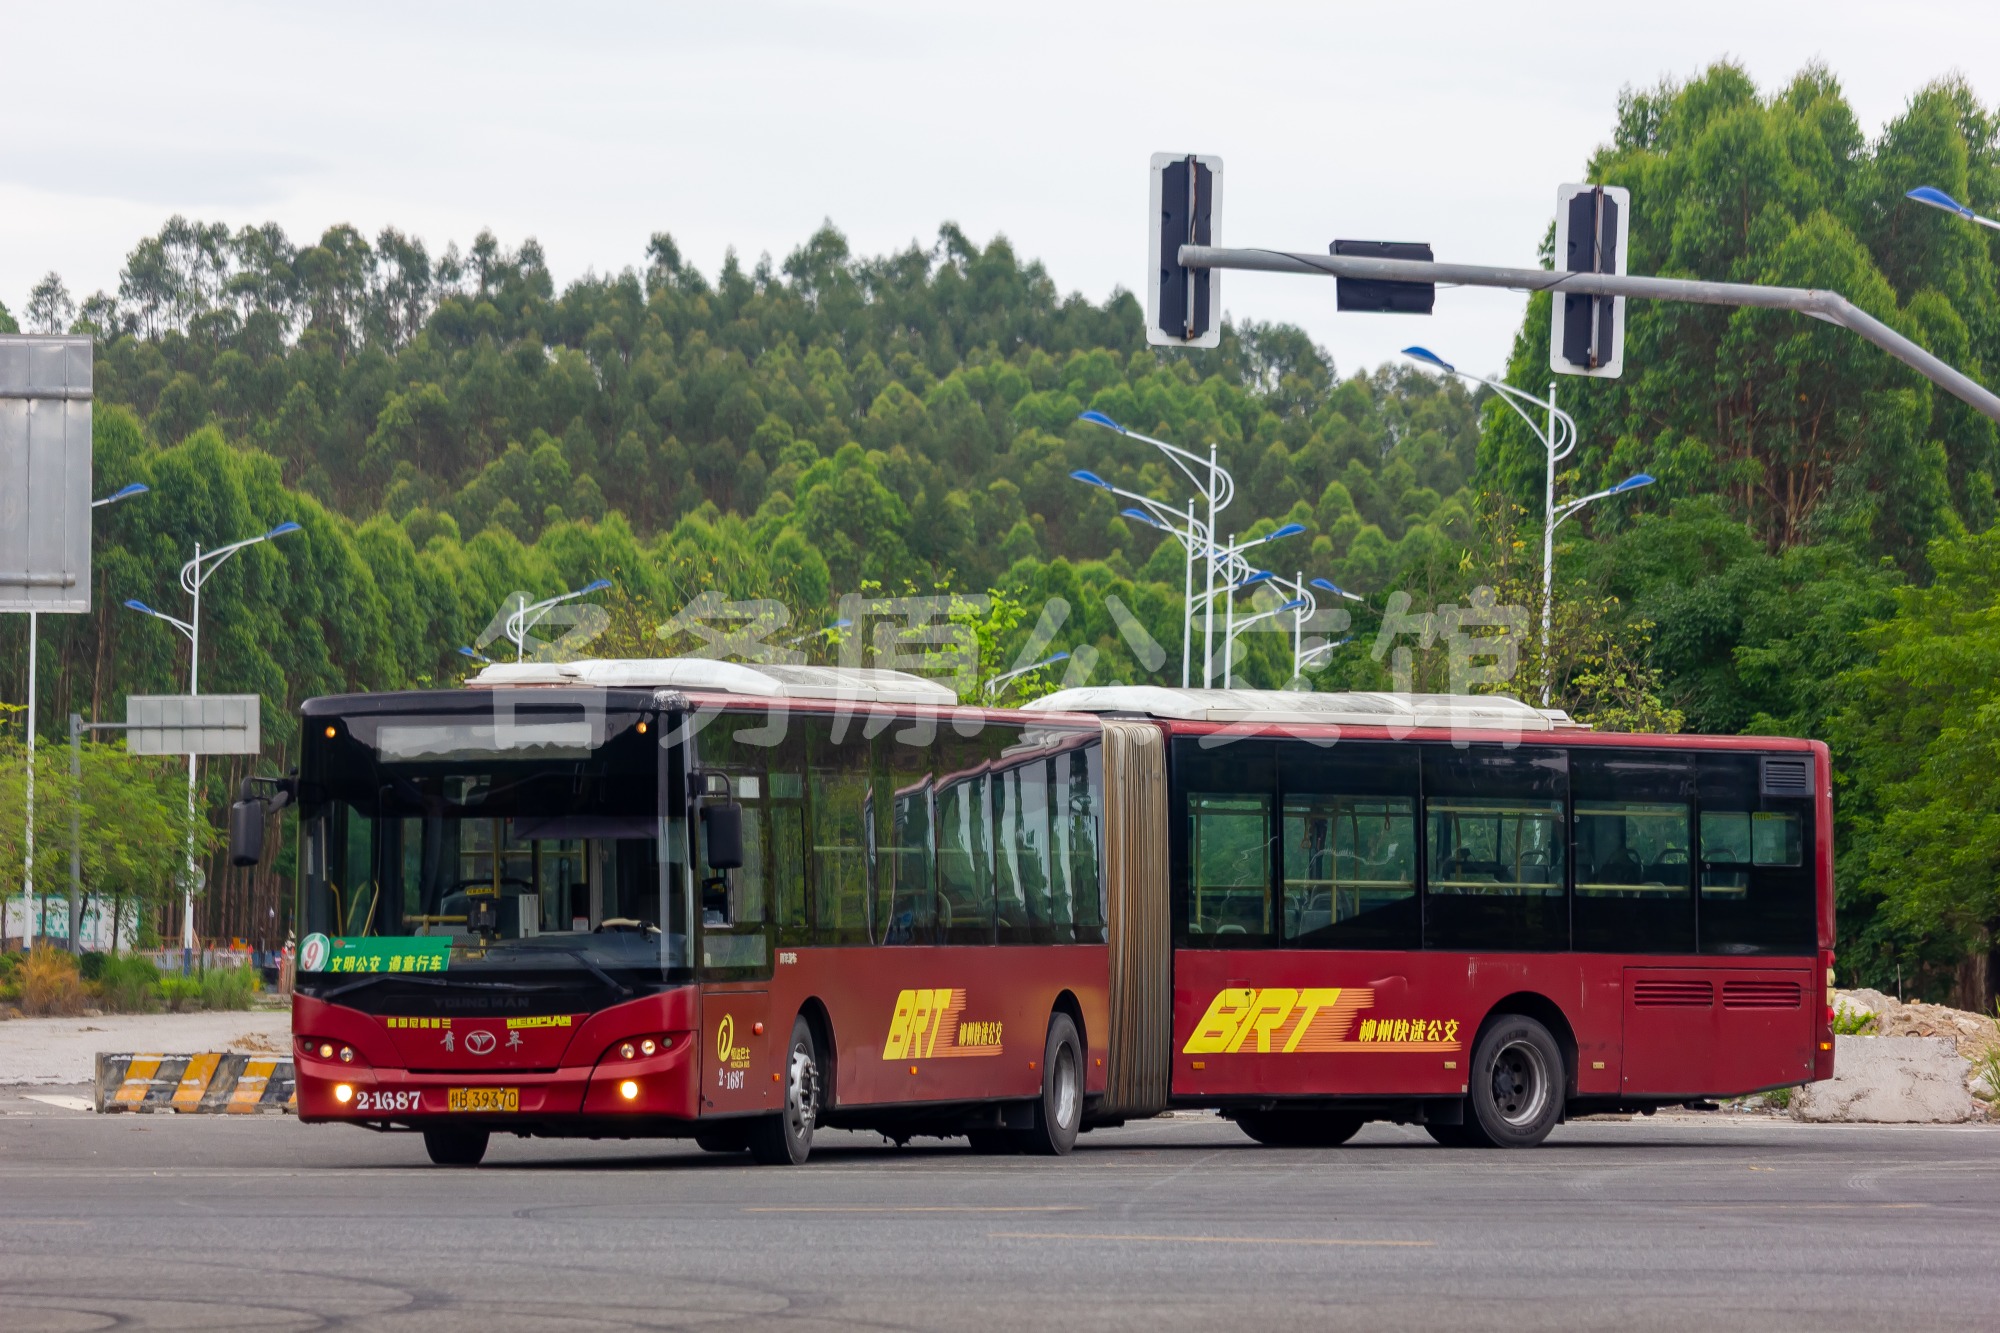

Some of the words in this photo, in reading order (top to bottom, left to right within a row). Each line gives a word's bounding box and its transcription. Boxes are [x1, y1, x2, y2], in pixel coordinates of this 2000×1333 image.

[305, 943, 318, 969] 9
[331, 955, 381, 972] 文明公交
[389, 955, 442, 972] 遵章行车
[507, 1015, 572, 1029] NEOPLAN
[883, 989, 952, 1060] BRT
[1182, 988, 1341, 1054] BRT
[1358, 1018, 1460, 1042] 柳州快速公交
[959, 1021, 1003, 1046] 柳州快速公交
[356, 1091, 421, 1110] 2-1687
